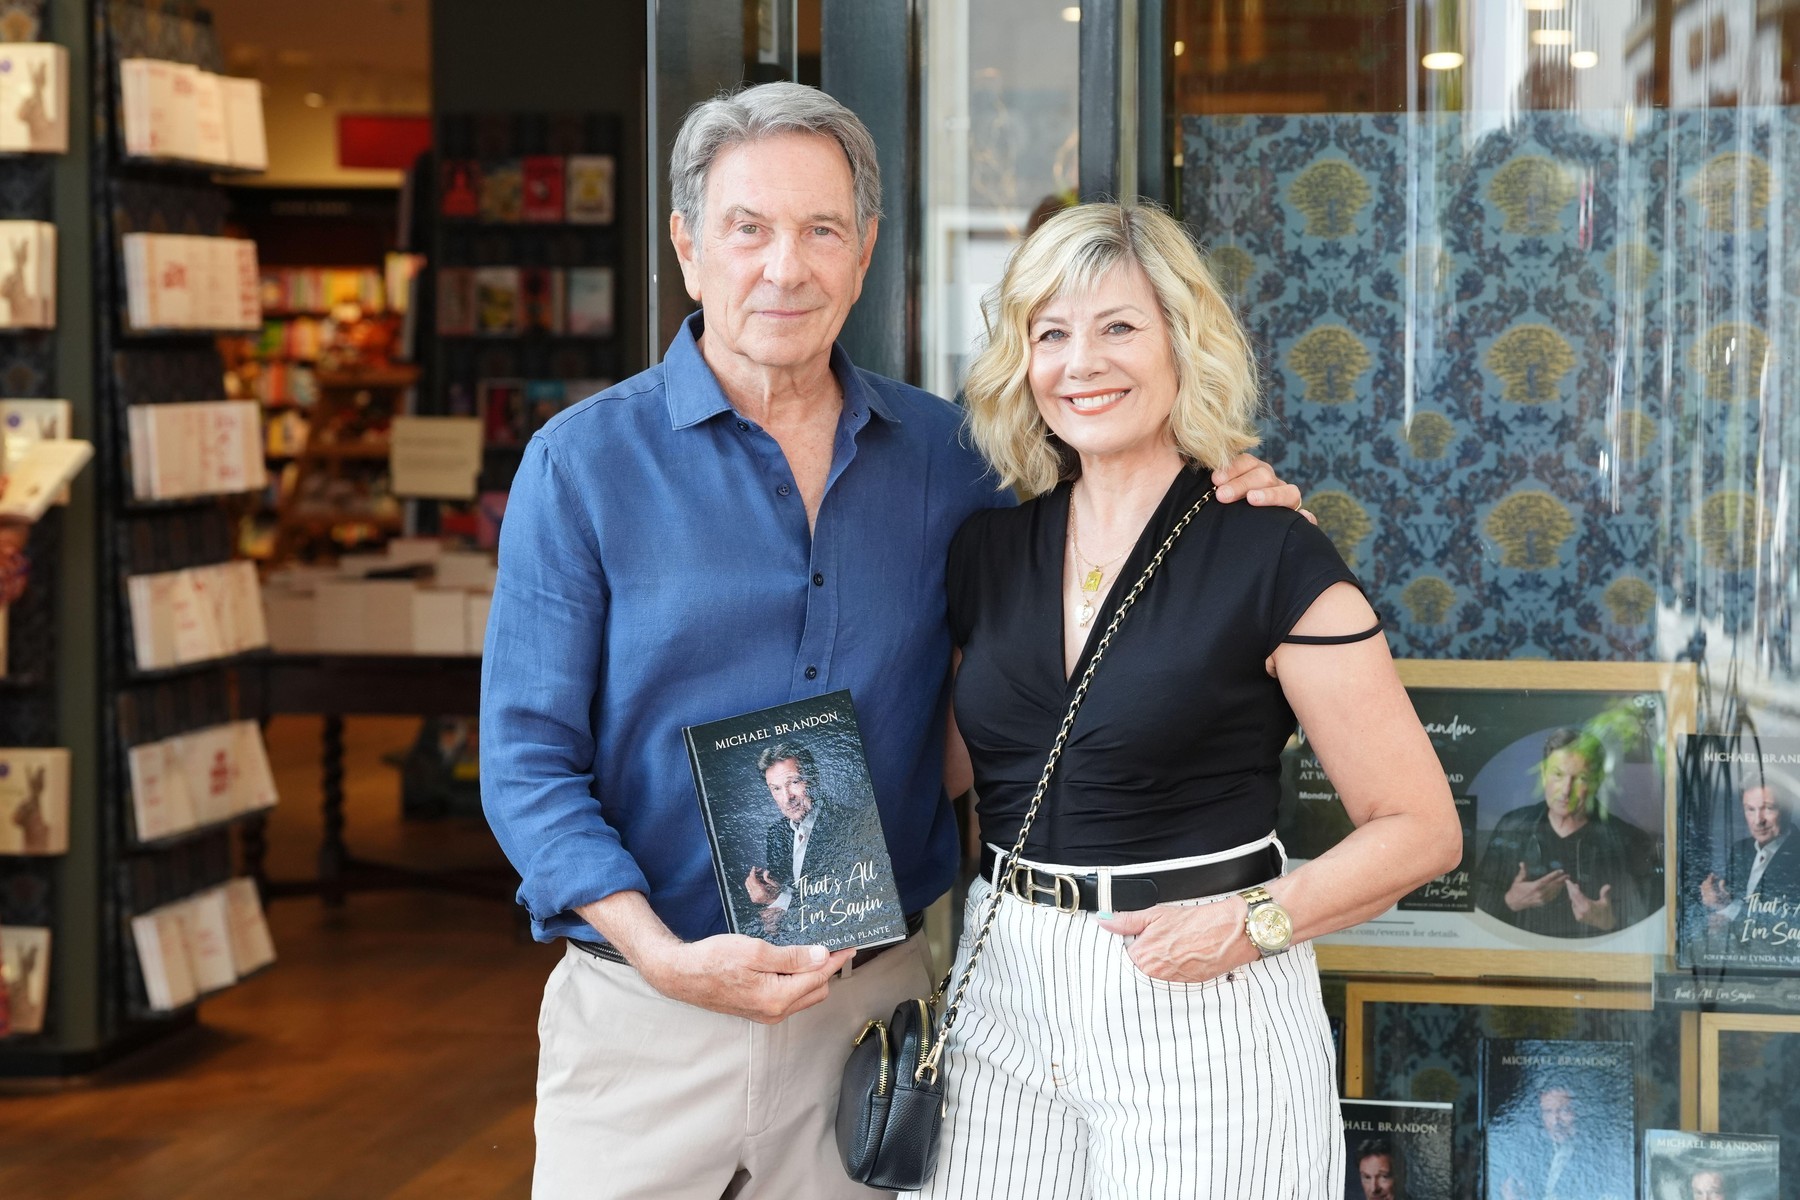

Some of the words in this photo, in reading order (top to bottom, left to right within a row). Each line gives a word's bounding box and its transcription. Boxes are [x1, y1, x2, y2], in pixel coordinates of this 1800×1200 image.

[715, 728, 772, 750] MICHAEL
[774, 711, 839, 736] BRANDON
[1300, 759, 1312, 768] IN
[1704, 752, 1758, 763] MICHAEL
[1300, 771, 1314, 780] AT
[1299, 791, 1332, 801] Monday
[791, 869, 843, 904] That's
[845, 860, 878, 892] All
[799, 905, 827, 933] I'm
[830, 887, 883, 926] Sayin'
[1743, 893, 1790, 918] That's
[844, 934, 855, 943] LA
[857, 925, 890, 940] PLANTE
[1741, 919, 1769, 942] I'm
[1501, 1056, 1553, 1066] MICHAEL
[1557, 1056, 1617, 1066] BRANDON
[1344, 1121, 1374, 1132] HAEL
[1378, 1122, 1438, 1134] BRANDON
[1656, 1138, 1706, 1149] MICHAEL
[1710, 1140, 1768, 1152] BRANDON
